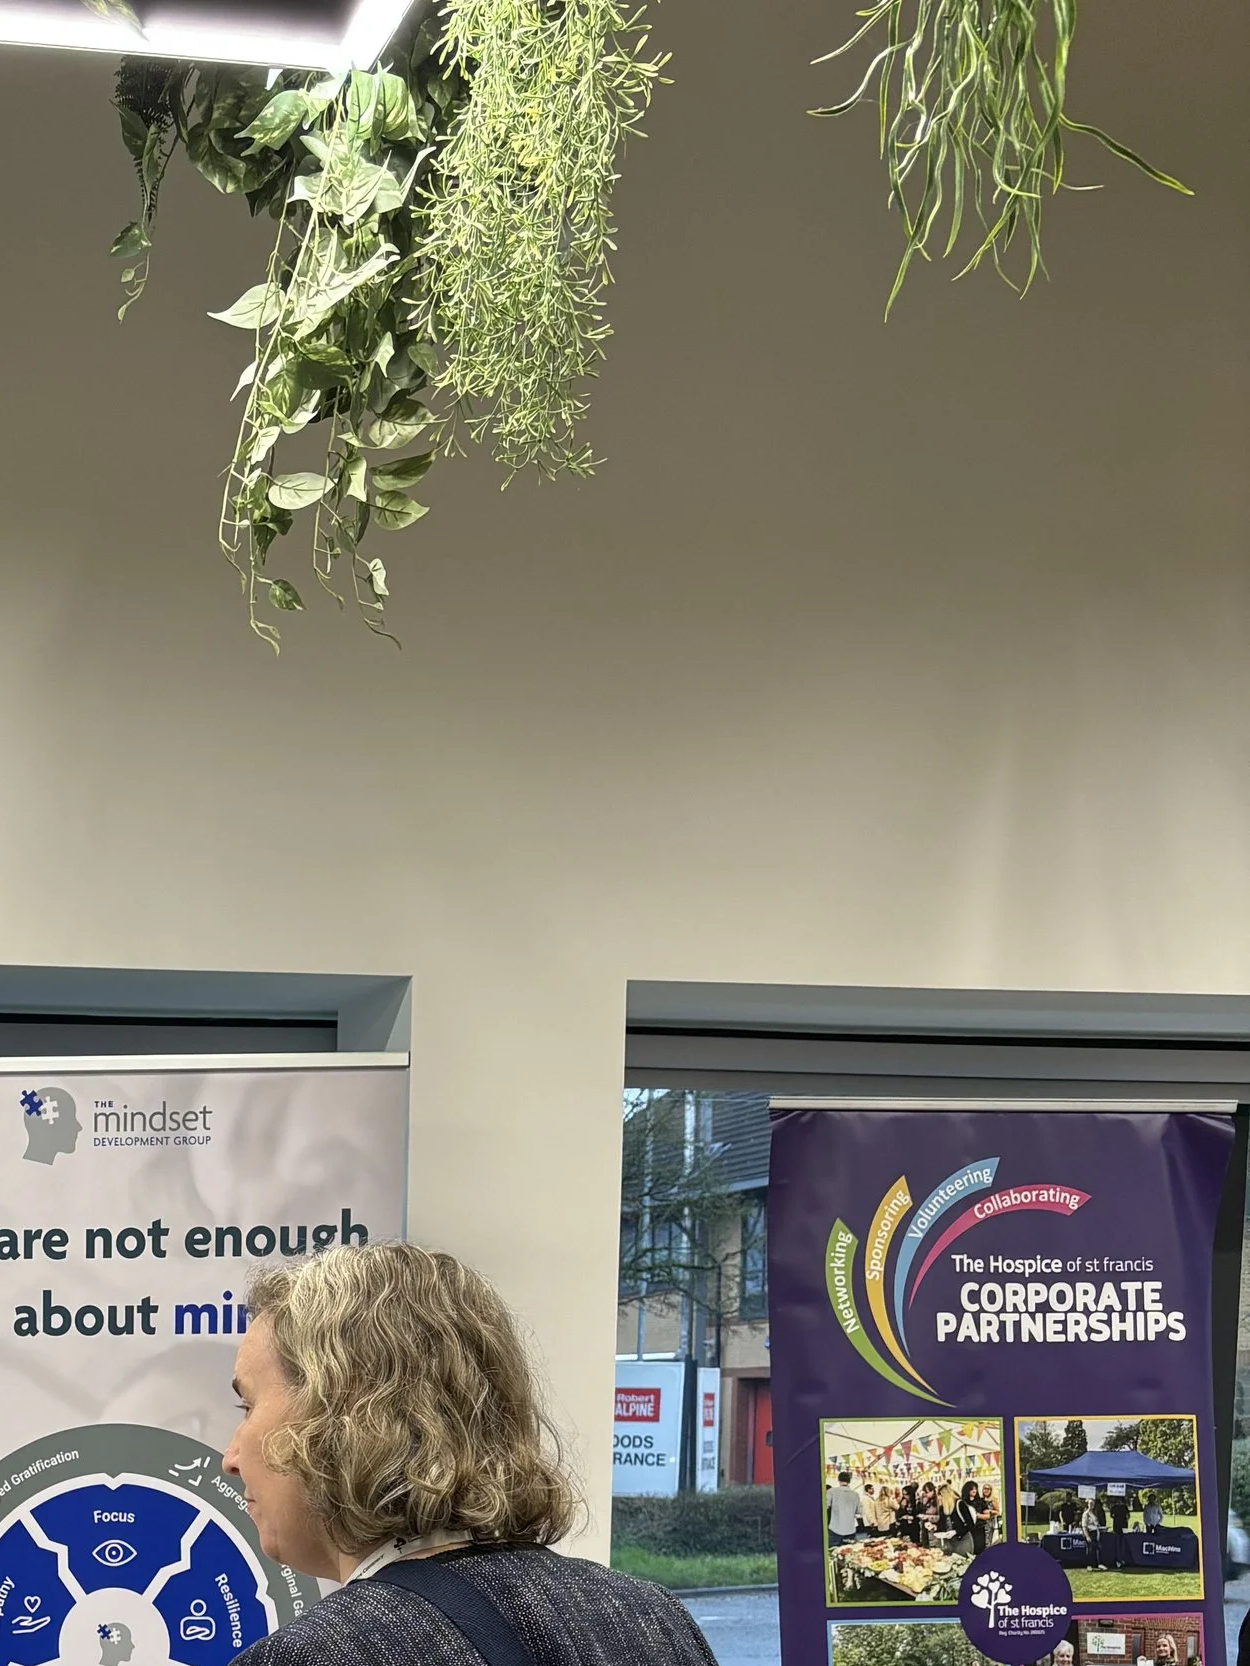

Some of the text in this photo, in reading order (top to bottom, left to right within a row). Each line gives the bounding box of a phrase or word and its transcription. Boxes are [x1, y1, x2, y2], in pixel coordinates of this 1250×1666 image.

[93, 1101, 213, 1133] mindset
[94, 1100, 114, 1109] THE
[93, 1134, 212, 1147] DEVELOPMENT GROUP
[908, 1165, 994, 1240] Volunteering
[973, 1188, 1082, 1221] Collaborating
[86, 1218, 170, 1260] not
[184, 1208, 369, 1258] enough
[867, 1189, 911, 1281] Sponsoring
[834, 1230, 859, 1334] Networking
[951, 1254, 1154, 1278] The Hospice of st francis
[960, 1280, 1163, 1311] CORPORATE
[14, 1290, 158, 1336] about
[936, 1311, 1186, 1343] PARTNERSHIPS
[615, 1402, 655, 1417] ALPINE
[616, 1393, 655, 1403] Robert
[10, 1449, 80, 1486] Gratification
[93, 1508, 136, 1525] Focus
[214, 1573, 243, 1648] Resilience
[997, 1603, 1068, 1618] The Hospice
[998, 1616, 1054, 1628] of st francis
